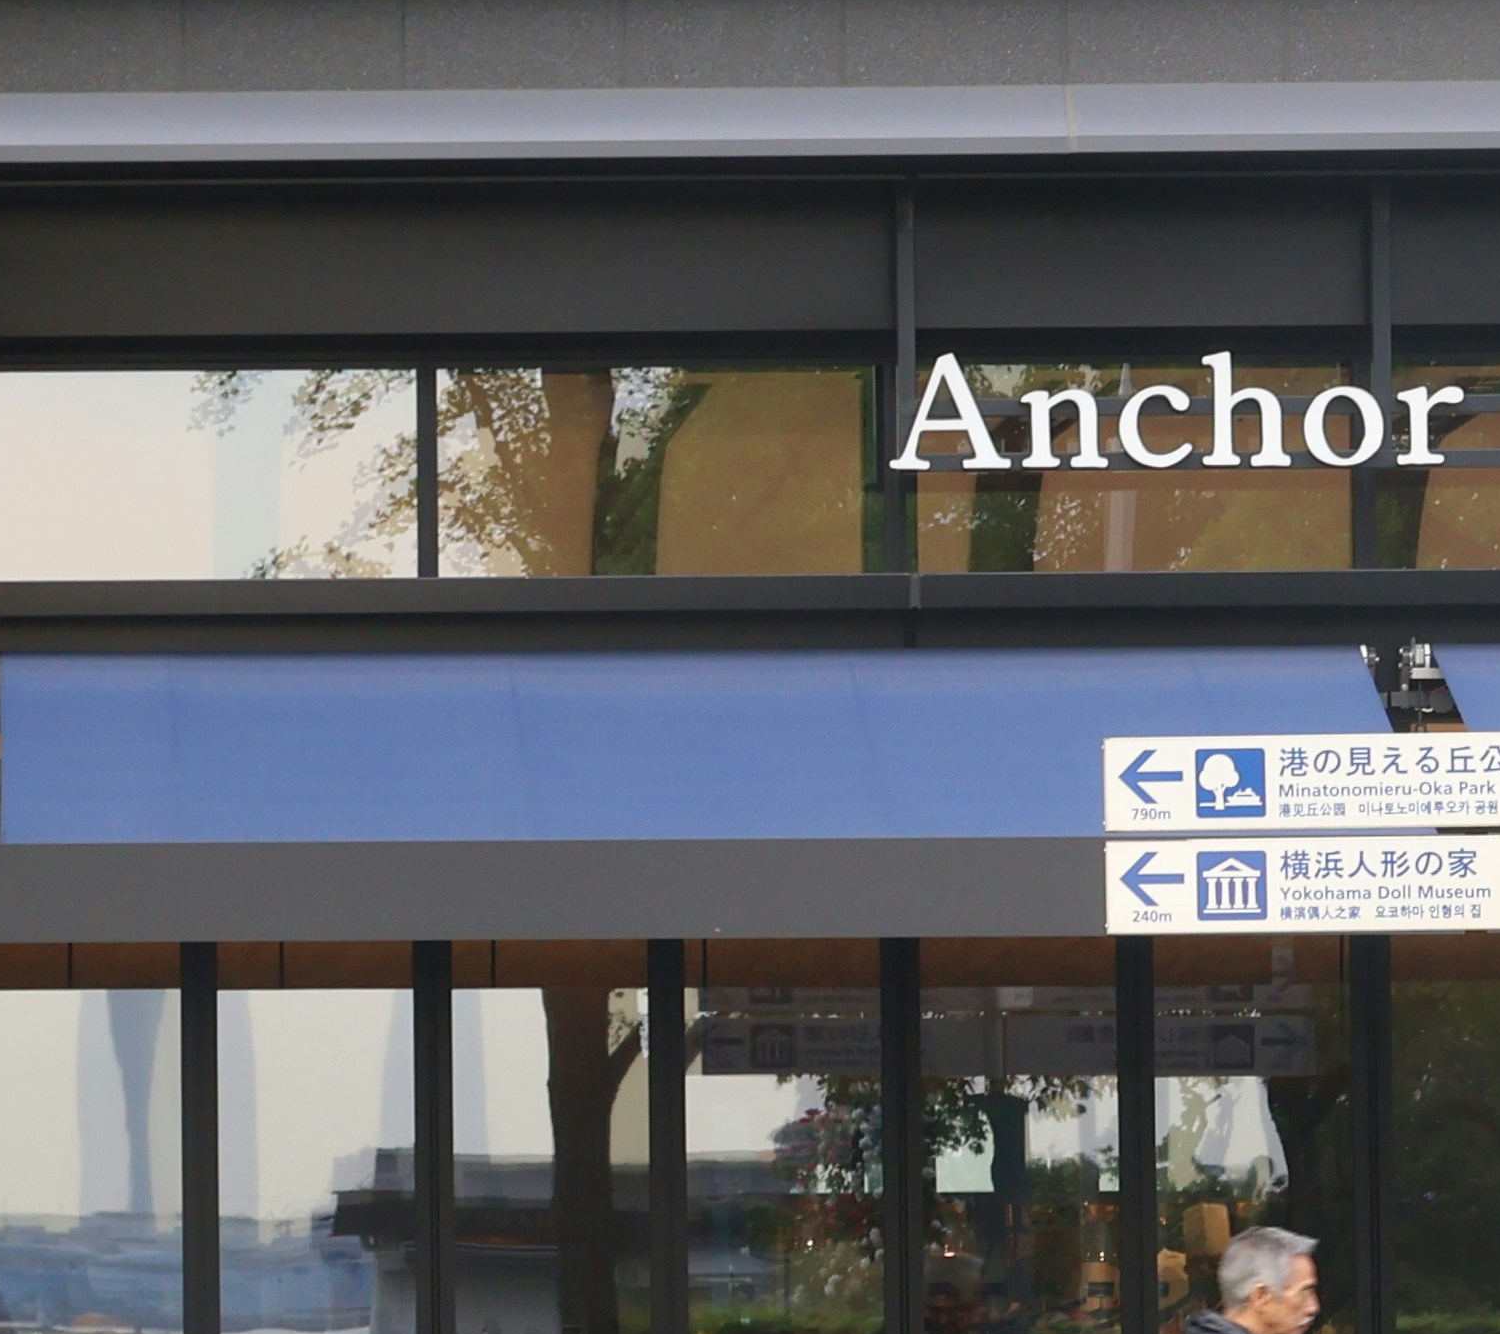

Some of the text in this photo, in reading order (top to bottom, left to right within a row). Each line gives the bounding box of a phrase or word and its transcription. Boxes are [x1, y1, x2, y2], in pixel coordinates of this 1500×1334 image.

[890, 351, 1463, 468] Anchor
[1279, 780, 1495, 798] Minatonomieru-Oka Park
[1132, 808, 1171, 820] 790m
[1475, 800, 1497, 814] 공원
[1280, 848, 1476, 880] 横浜人形の家
[1280, 885, 1491, 900] Yokohama Doll Museum
[1133, 910, 1172, 922] 240m
[1375, 905, 1424, 918] 요코하마
[1471, 904, 1481, 918] 집
